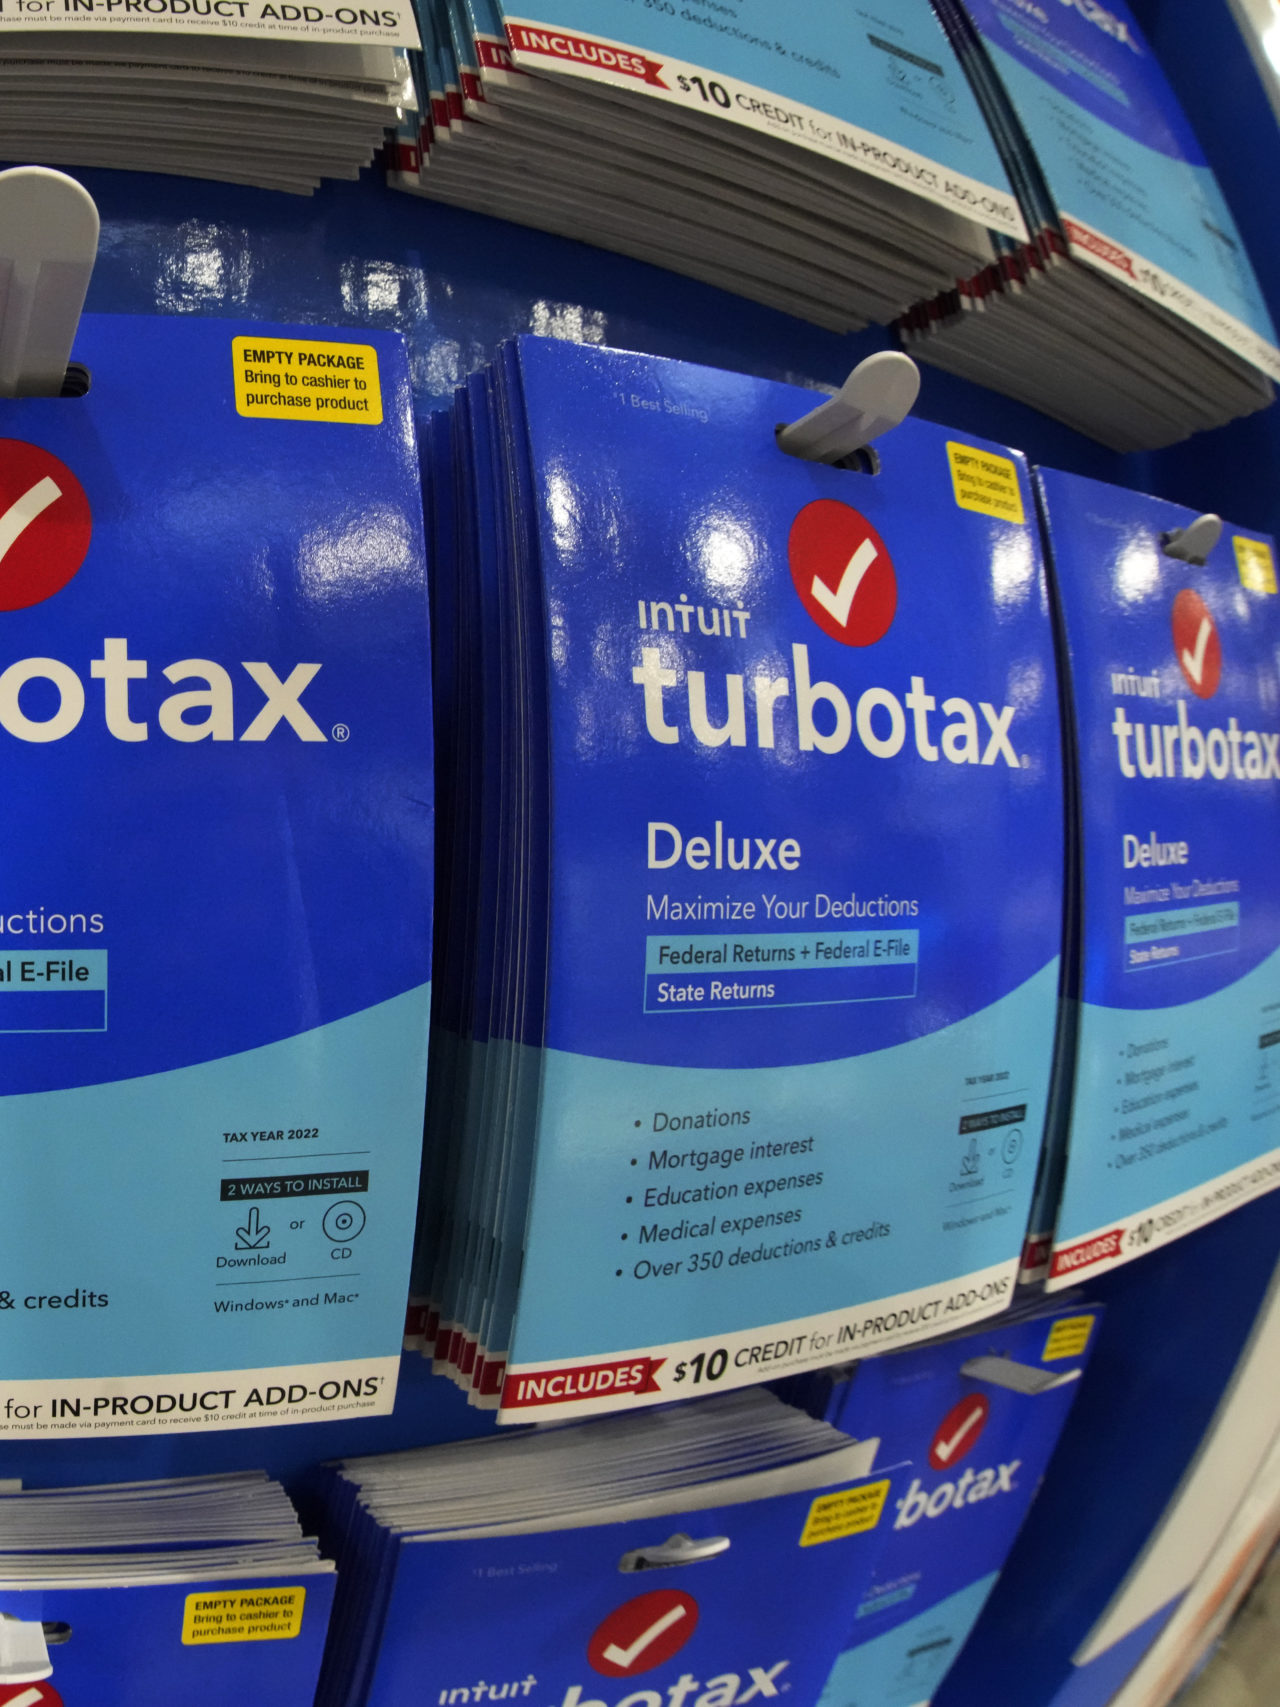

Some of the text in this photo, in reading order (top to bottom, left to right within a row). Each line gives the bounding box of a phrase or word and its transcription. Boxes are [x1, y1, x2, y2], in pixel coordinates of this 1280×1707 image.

[64, 0, 249, 17] IN-PRODUCT
[521, 30, 646, 75] INCLUDES
[677, 74, 731, 109] $10
[735, 93, 804, 133] CREDIT
[809, 119, 833, 142] for
[836, 131, 939, 189] IN-PRODUCT
[243, 349, 365, 370] EMPTY PACKAGE
[244, 371, 367, 390] Bring to cashier to
[246, 391, 369, 413] purchase product
[647, 820, 801, 871] Deluxe
[646, 893, 919, 920] Maximize Your Deductions
[20, 960, 90, 982] E-File
[657, 981, 775, 1003] State Returns
[223, 1128, 319, 1143] TAX YEAR 2022
[227, 1176, 362, 1196] 2 WAYS TO INSTALL
[289, 1219, 305, 1230] or
[216, 1252, 286, 1268] Download
[330, 1247, 353, 1260] CD
[23, 1288, 110, 1310] credits
[292, 1293, 319, 1308] and
[517, 1363, 643, 1400] INCLUDES
[672, 1348, 728, 1385] $10
[734, 1335, 807, 1368] CREDIT
[809, 1330, 834, 1353] for
[835, 1300, 942, 1346] IN-PRODUCT
[5, 1398, 43, 1419] for
[51, 1390, 236, 1418] IN-PRODUCT
[11, 1422, 34, 1430] must
[36, 1422, 48, 1430] be
[79, 1421, 92, 1429] via
[94, 1420, 134, 1430] payment
[136, 1418, 156, 1426] card
[169, 1416, 201, 1424] receive
[203, 1414, 220, 1422] $10
[221, 1412, 246, 1421] credit
[258, 1409, 278, 1418] time
[280, 1408, 289, 1416] of
[291, 1404, 336, 1415] in-product
[337, 1400, 376, 1412] purchase
[195, 1595, 296, 1611] EMPTY PACKAGE
[193, 1609, 293, 1625] Bring to cashier to
[192, 1622, 292, 1639] purchase product
